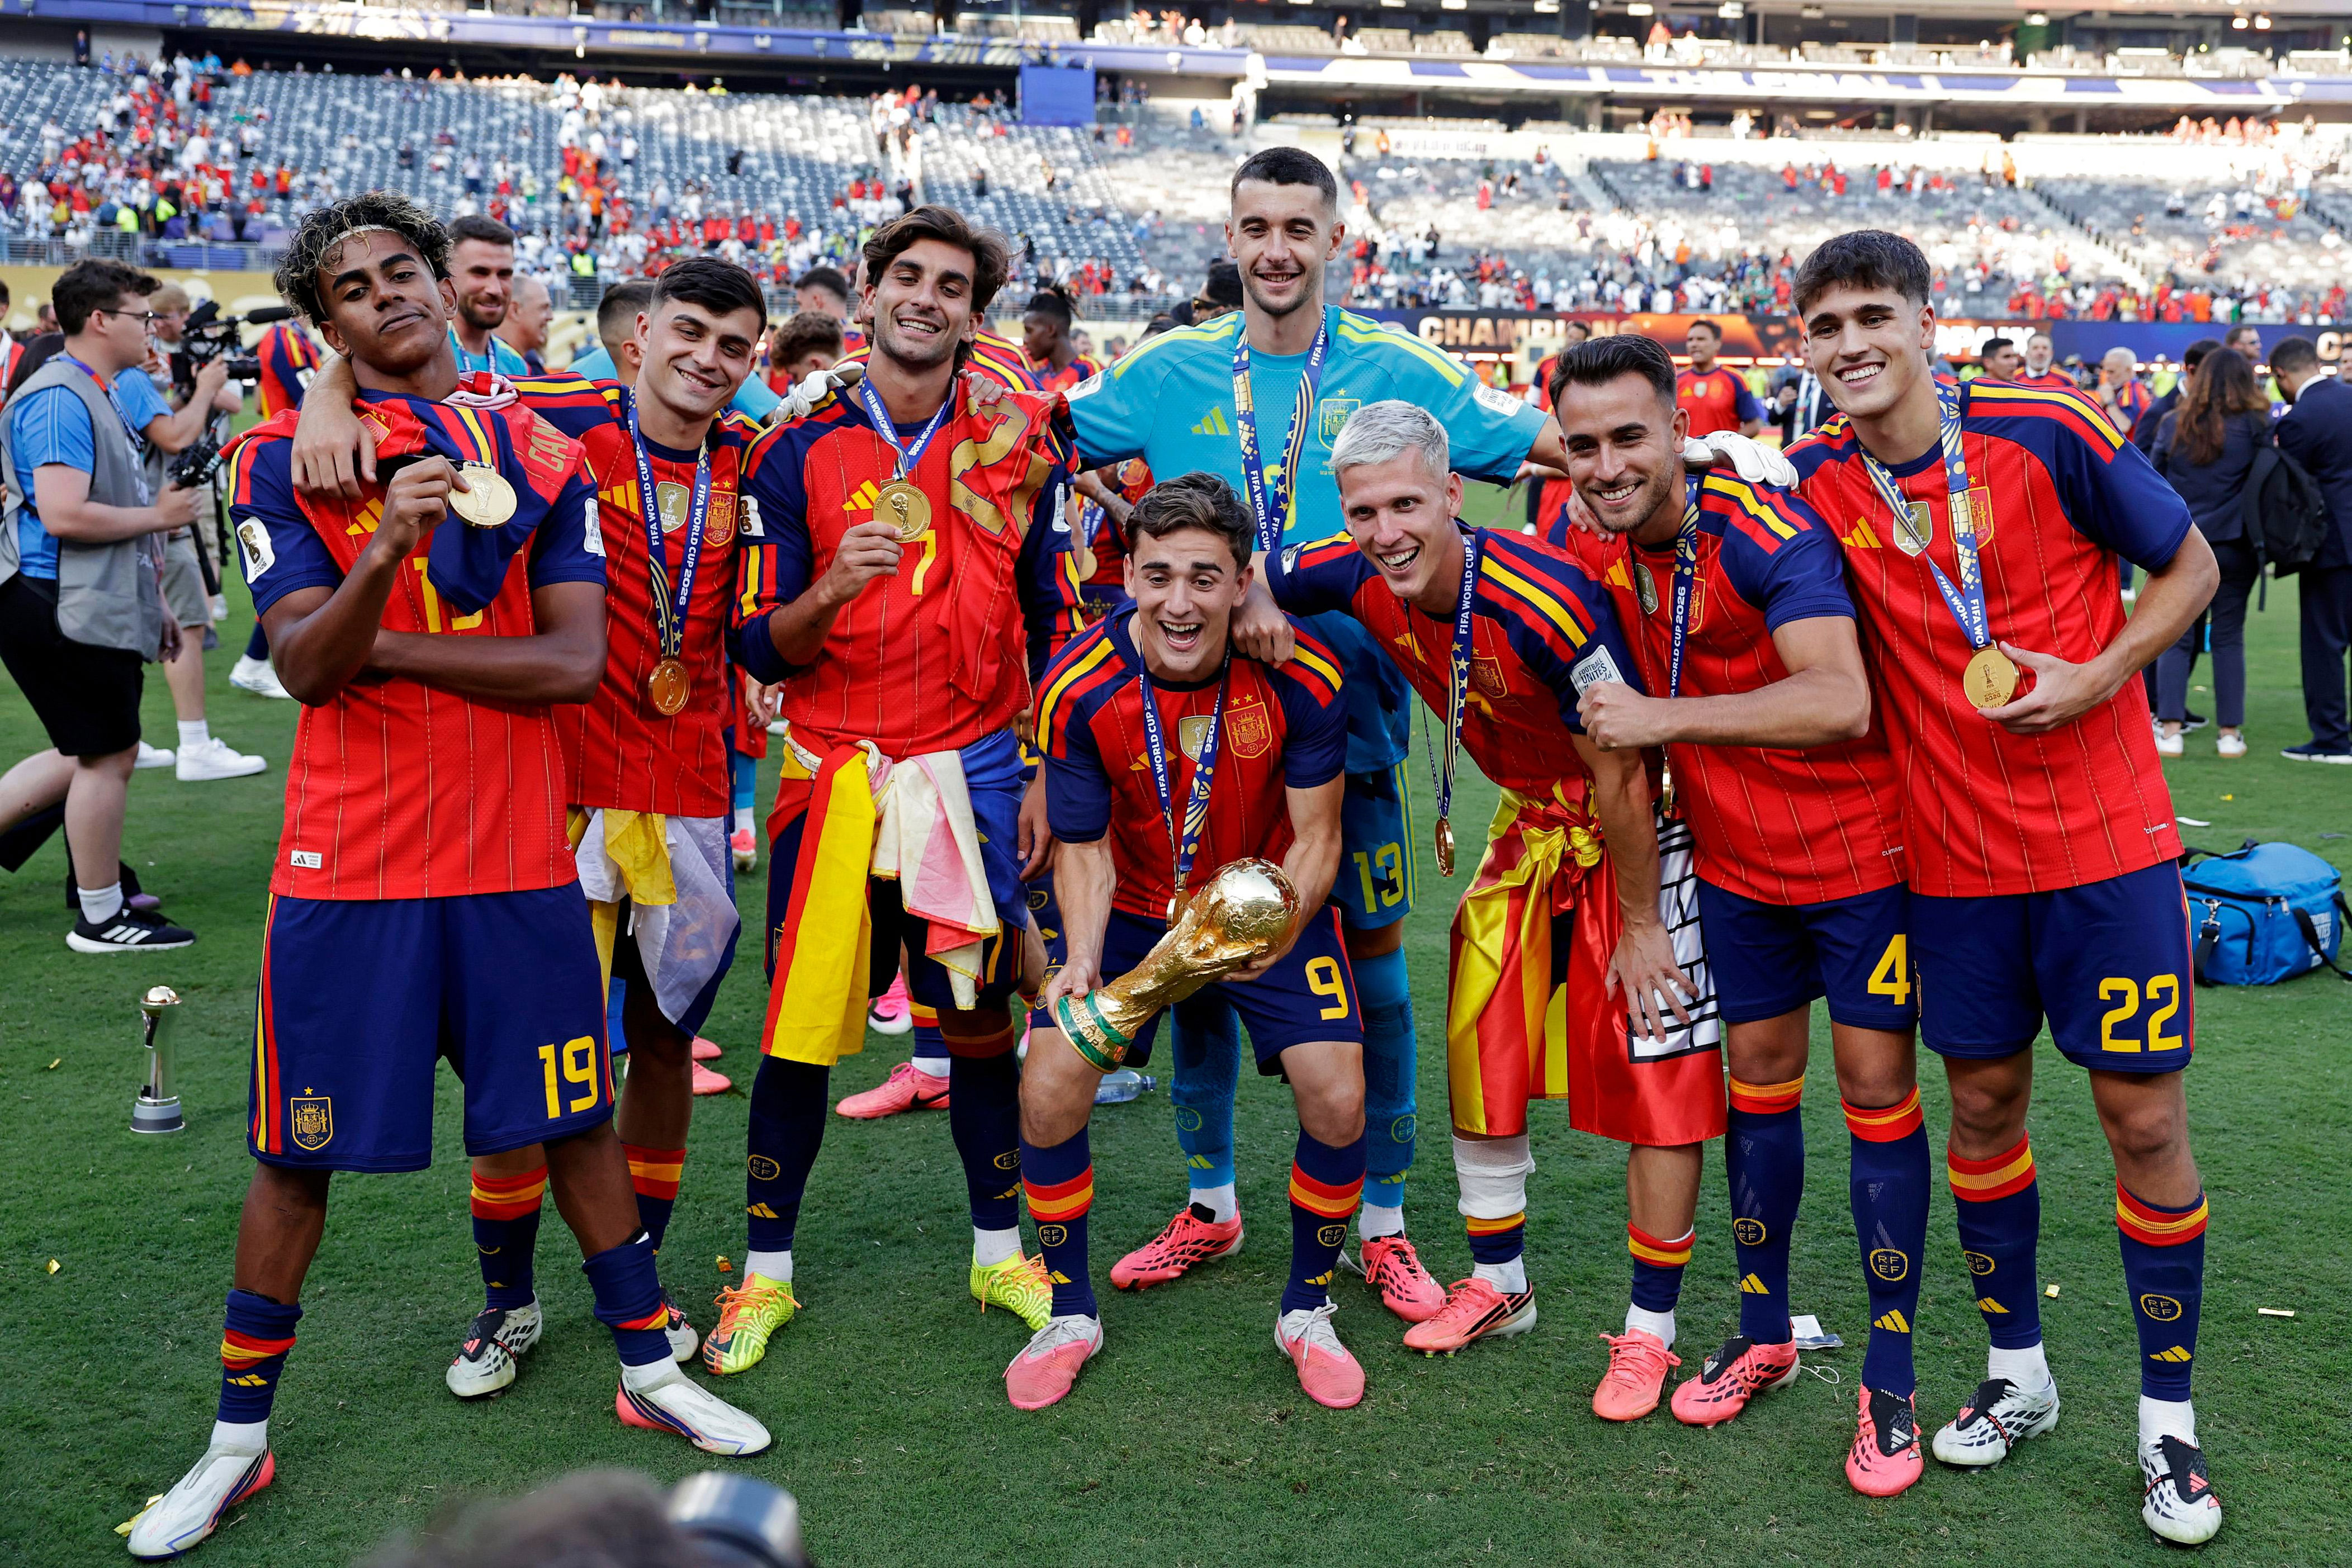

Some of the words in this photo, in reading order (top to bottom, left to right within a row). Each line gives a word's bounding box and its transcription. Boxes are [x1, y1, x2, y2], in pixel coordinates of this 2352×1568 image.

[1418, 316, 1618, 345] CHAMPIN
[1310, 347, 1322, 367] FIFA
[865, 389, 877, 405] FIFA
[871, 401, 885, 423] WORLD
[639, 461, 650, 481] CUP
[1251, 470, 1261, 492] FIFA
[643, 484, 657, 522] WORLD
[695, 484, 707, 506] FIFA
[1255, 492, 1267, 530] WORLD
[650, 521, 660, 546] FIFA
[690, 508, 703, 546] WORLD
[1261, 530, 1271, 551] CUP
[687, 546, 697, 569] CUP
[1465, 547, 1474, 569] CUP
[679, 568, 692, 606] 2026
[1462, 570, 1473, 610] WORLD
[1938, 575, 1953, 597] FIFA
[1675, 586, 1686, 624] 2026
[1970, 598, 1981, 624] FIFA
[1459, 611, 1470, 634] FIFA
[1674, 626, 1682, 648] CUP
[1578, 657, 1603, 677] FOOTBALL
[1580, 662, 1607, 684] UNITES
[1670, 648, 1680, 687] WORLD
[1146, 711, 1157, 734] CUP
[1204, 716, 1217, 754] 2026
[1149, 733, 1164, 776] WORLD
[1156, 776, 1167, 798] FIFA
[1353, 841, 1401, 913] 13
[1867, 934, 1910, 1005] 4
[1304, 956, 1349, 1021] 9
[1068, 998, 1083, 1025] ORLD
[2098, 973, 2184, 1053] 22
[537, 1035, 599, 1120] 19
[1878, 1254, 1900, 1263] RF
[1880, 1264, 1900, 1274] EF
[2150, 1307, 2171, 1316] EF
